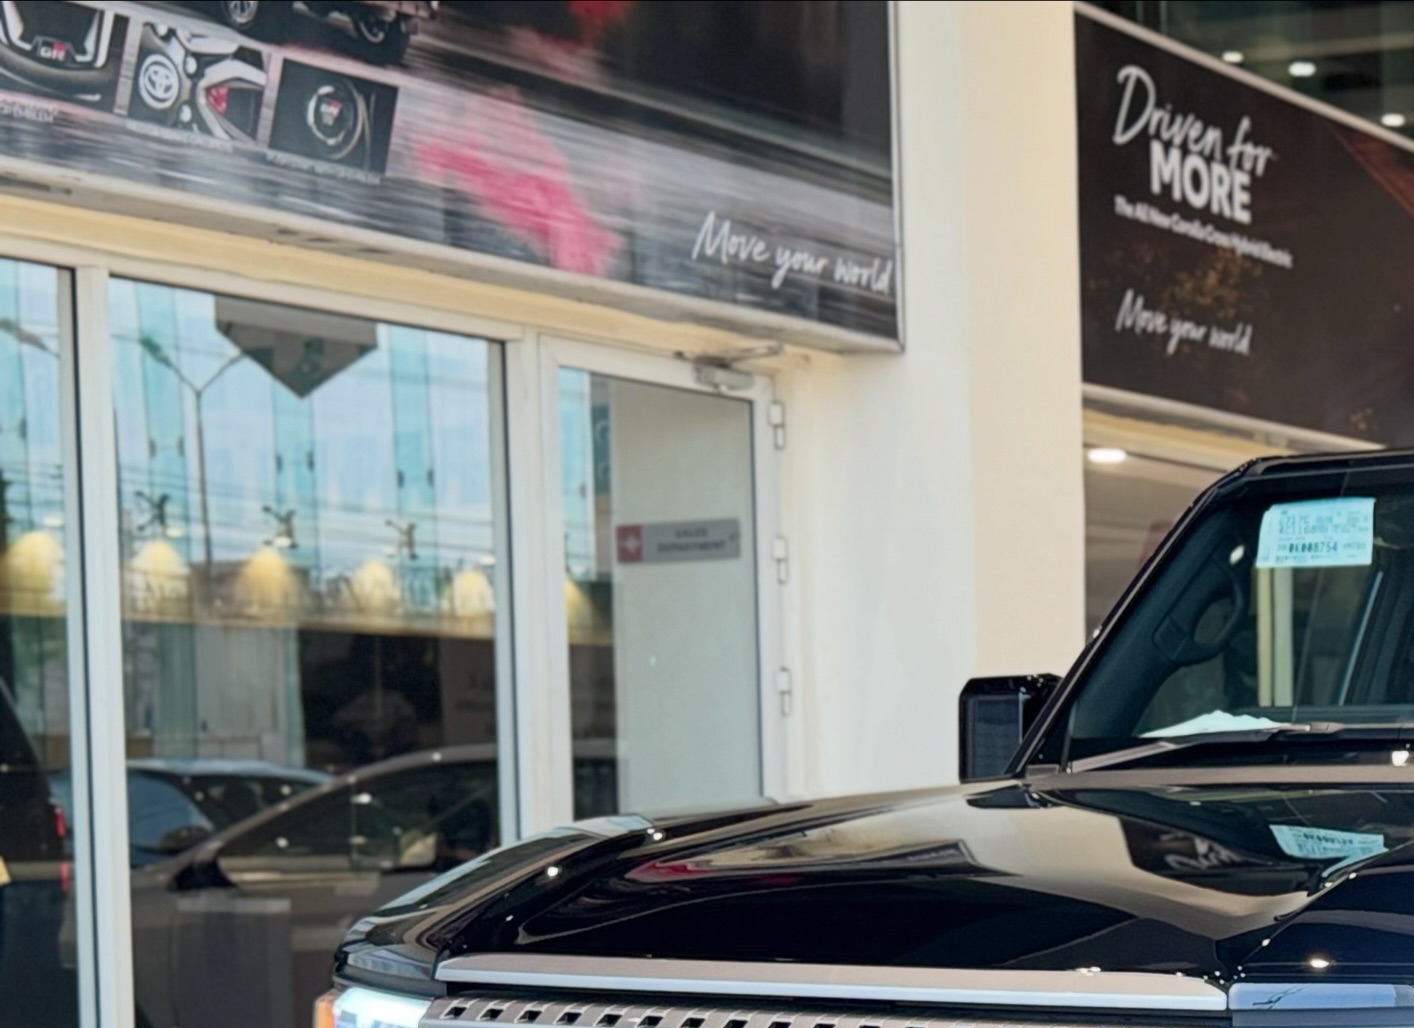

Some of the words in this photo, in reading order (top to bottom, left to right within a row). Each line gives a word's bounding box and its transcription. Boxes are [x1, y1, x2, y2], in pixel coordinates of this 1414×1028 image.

[1112, 64, 1222, 163] Driven
[1226, 115, 1276, 178] for
[1150, 138, 1252, 226] MORE
[690, 210, 770, 265] Move
[771, 246, 829, 290] your
[834, 256, 893, 294] world
[1114, 288, 1168, 334] Move
[1166, 318, 1207, 356] your
[1208, 322, 1252, 356] world
